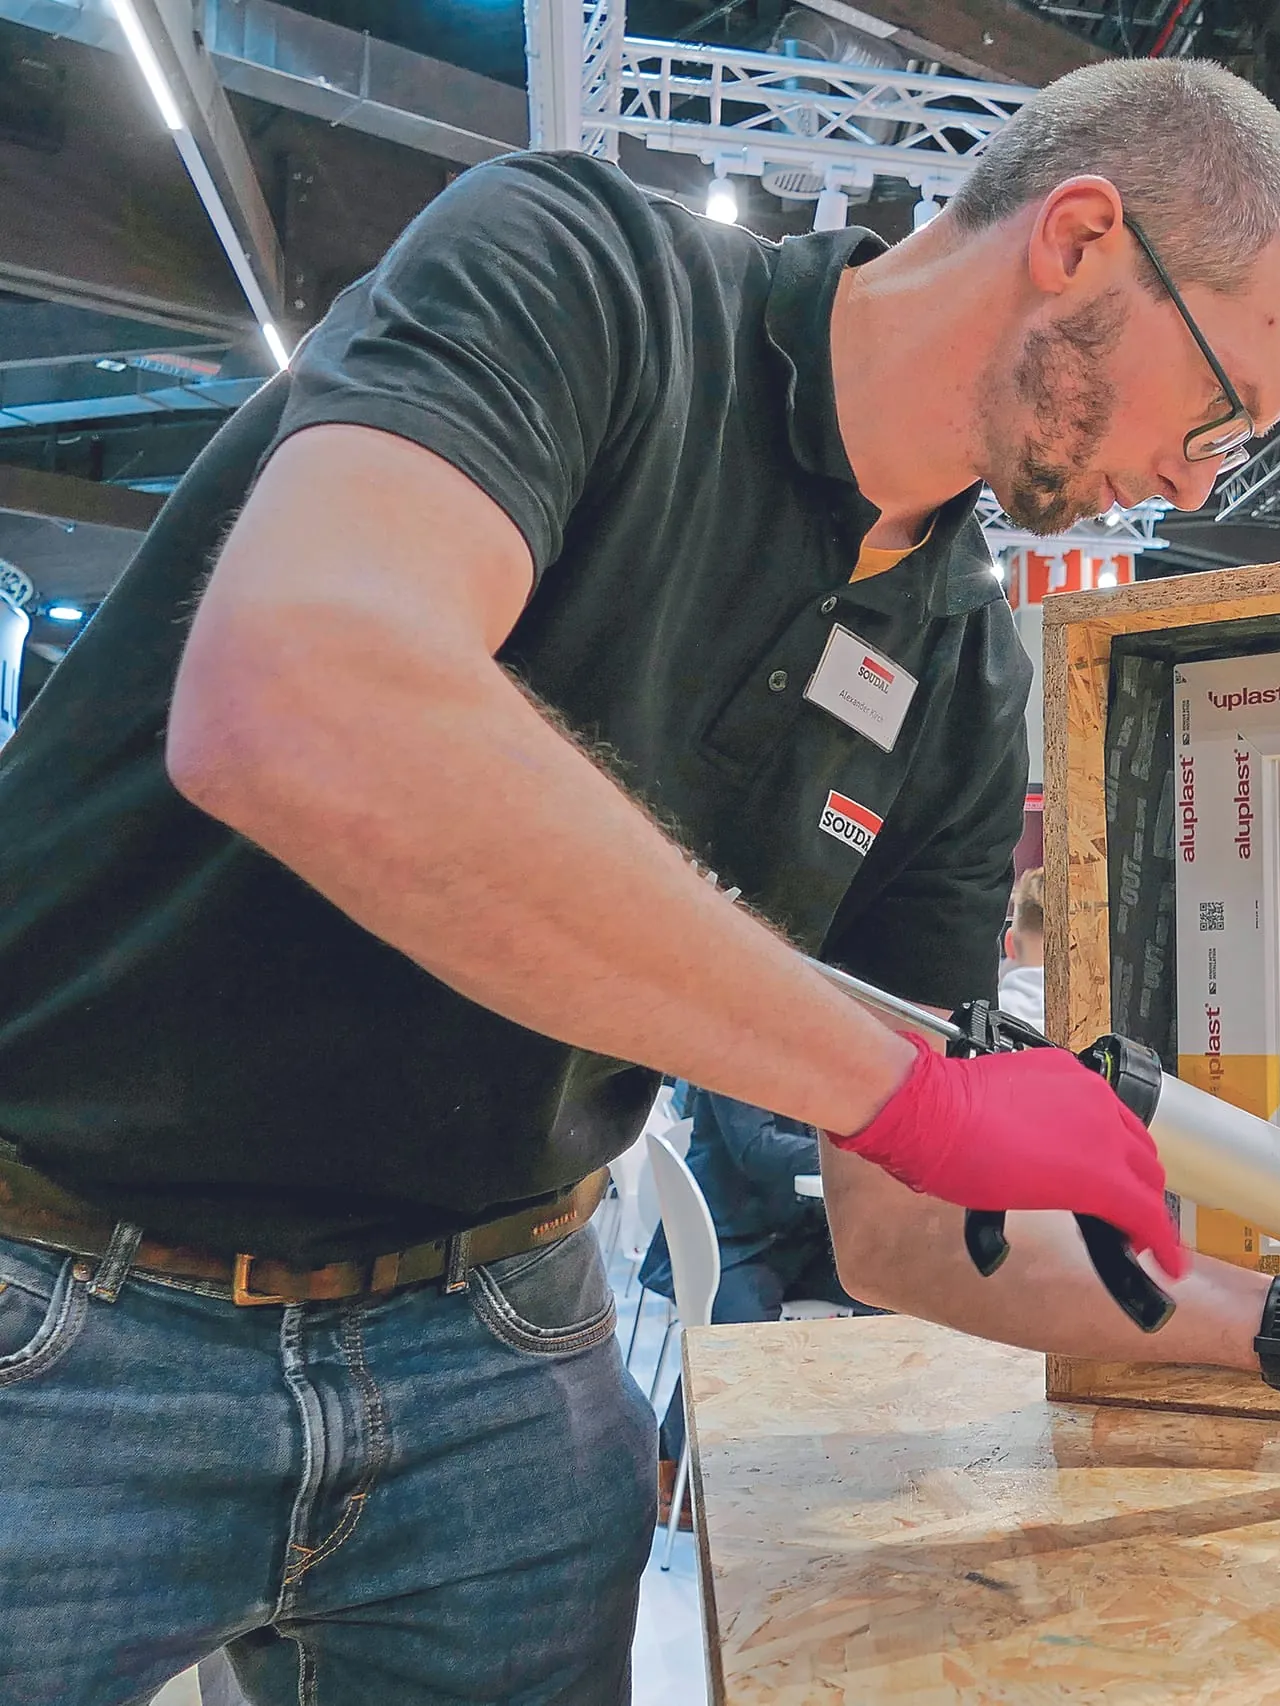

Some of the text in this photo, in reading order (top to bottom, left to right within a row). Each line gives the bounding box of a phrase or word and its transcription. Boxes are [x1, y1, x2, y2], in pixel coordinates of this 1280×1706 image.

[858, 667, 889, 694] SOUDAL
[1180, 756, 1199, 863] aluplast
[1234, 751, 1253, 859] aluplast
